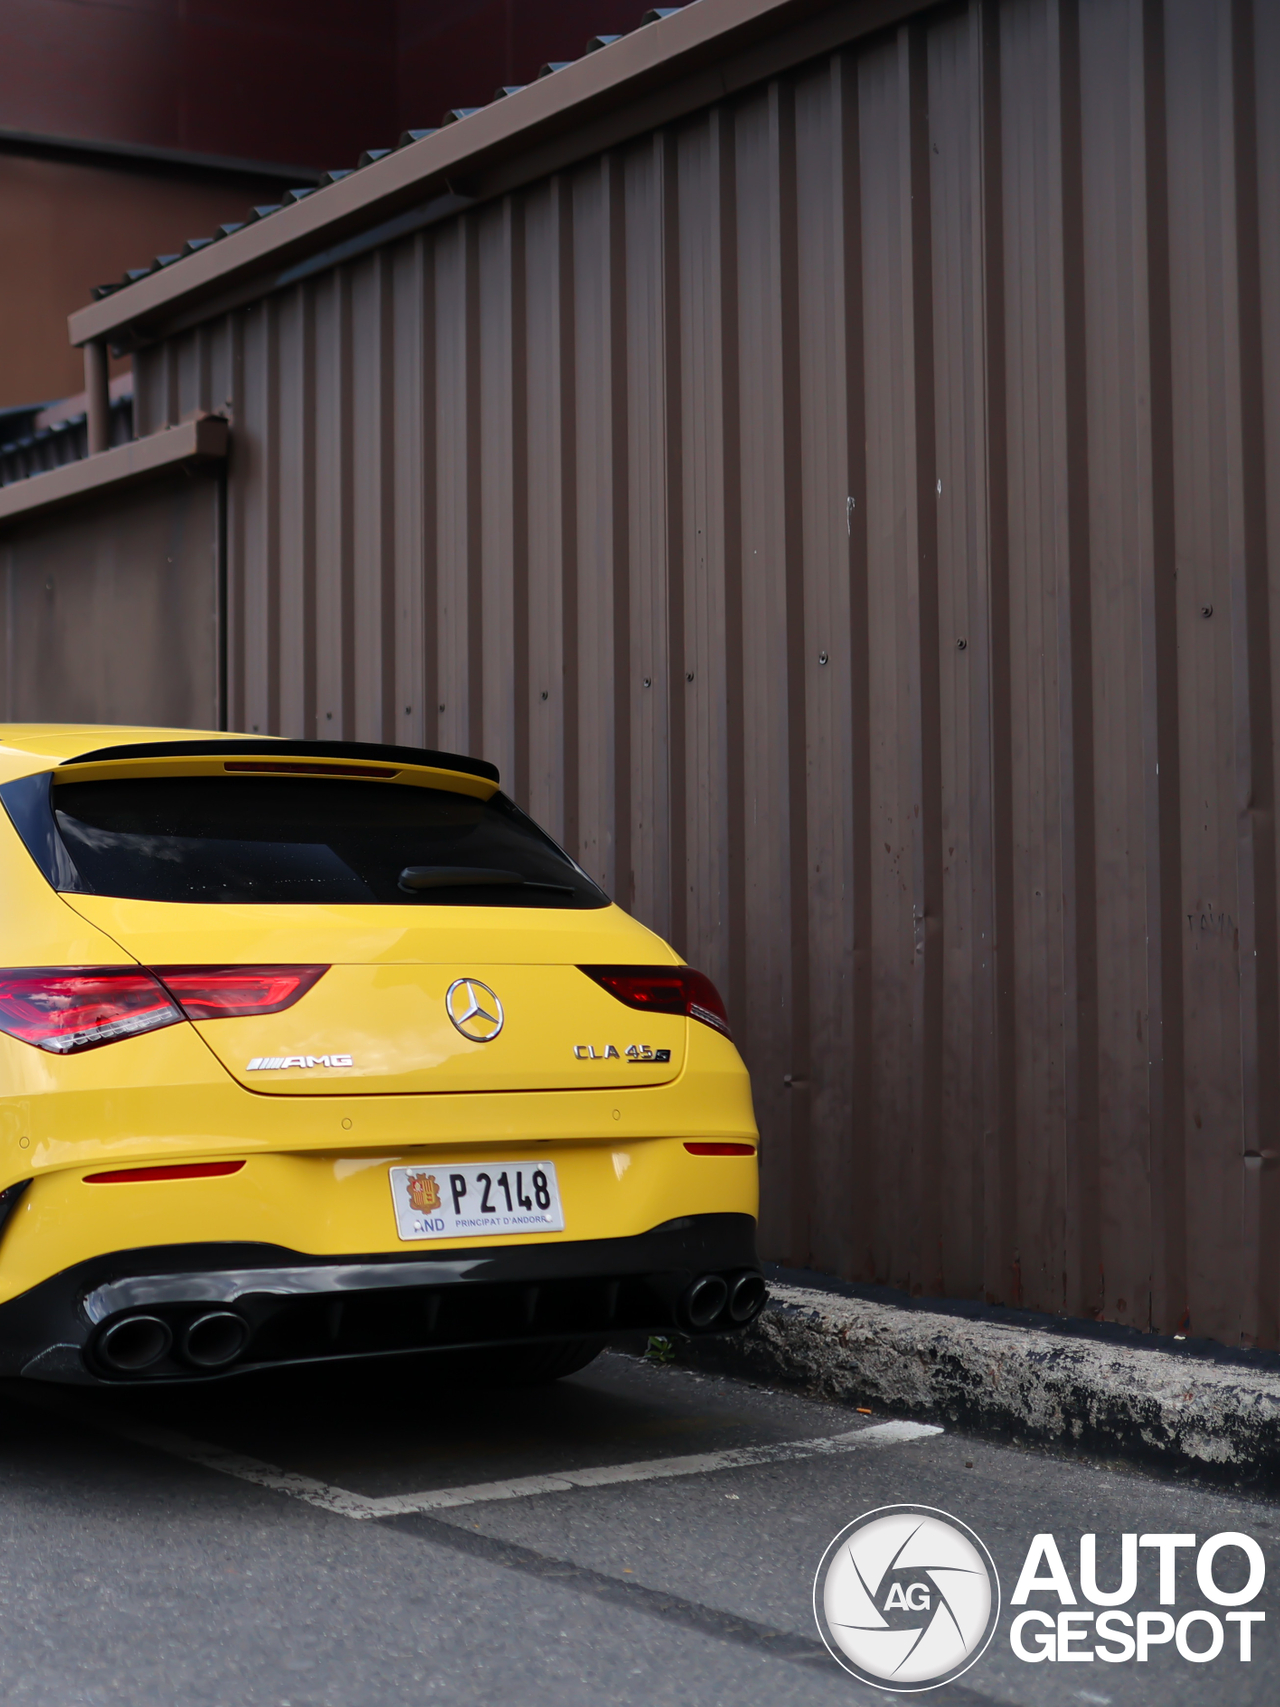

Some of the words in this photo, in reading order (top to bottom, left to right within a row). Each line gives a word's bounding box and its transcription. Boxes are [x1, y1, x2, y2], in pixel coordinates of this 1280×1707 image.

[573, 1045, 620, 1060] CLA
[624, 1044, 653, 1059] 45
[280, 1054, 354, 1069] AMG
[449, 1174, 467, 1214] P
[476, 1170, 551, 1213] 2148
[455, 1217, 501, 1228] PRINCIPAT
[503, 1215, 554, 1226] D'ANDORR
